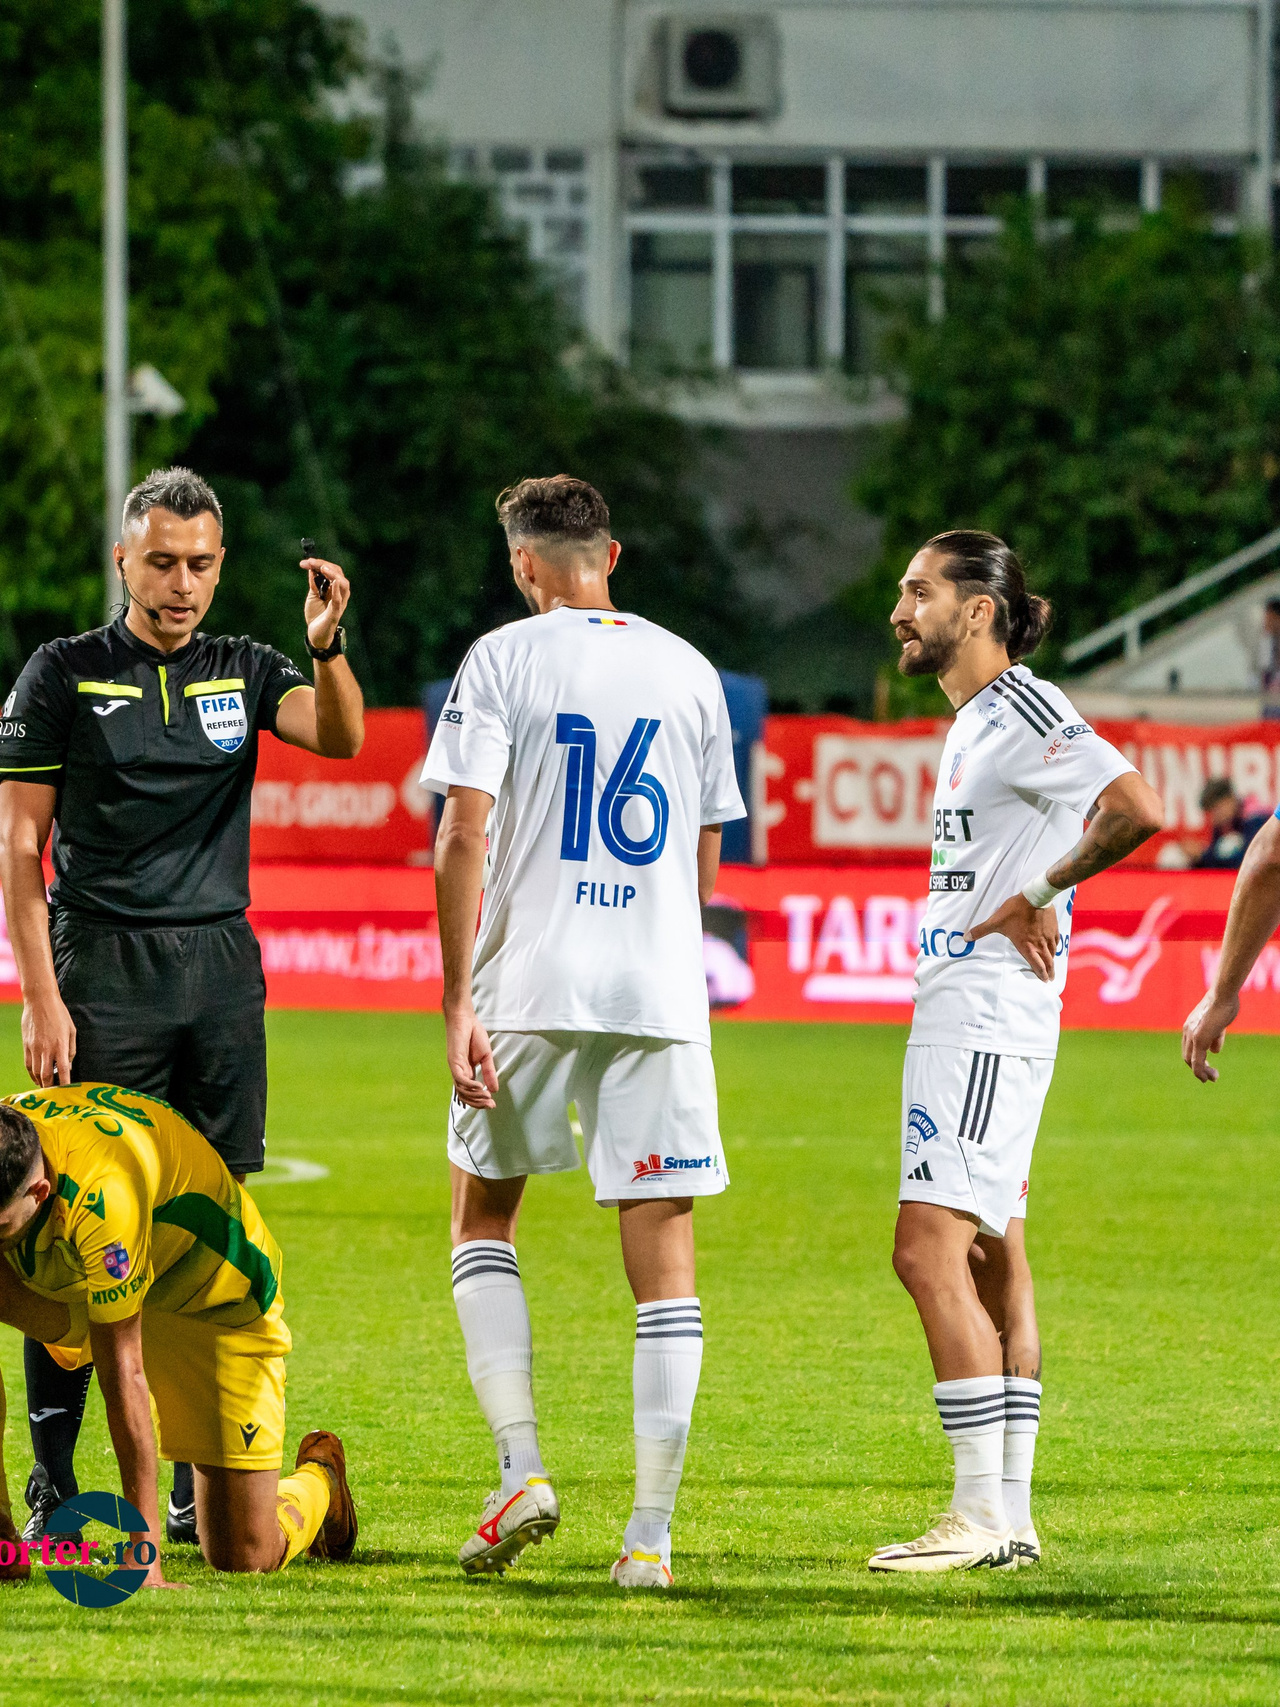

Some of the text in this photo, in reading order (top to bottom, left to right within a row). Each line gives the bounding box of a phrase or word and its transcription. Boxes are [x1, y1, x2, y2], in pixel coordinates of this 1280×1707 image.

[201, 697, 240, 713] FIFA
[206, 719, 245, 731] REFEREE
[221, 738, 239, 748] 2024
[556, 713, 670, 867] 16
[933, 808, 974, 842] BET
[951, 875, 968, 890] 0%
[576, 881, 636, 909] FILIP
[663, 1156, 711, 1169] Smart
